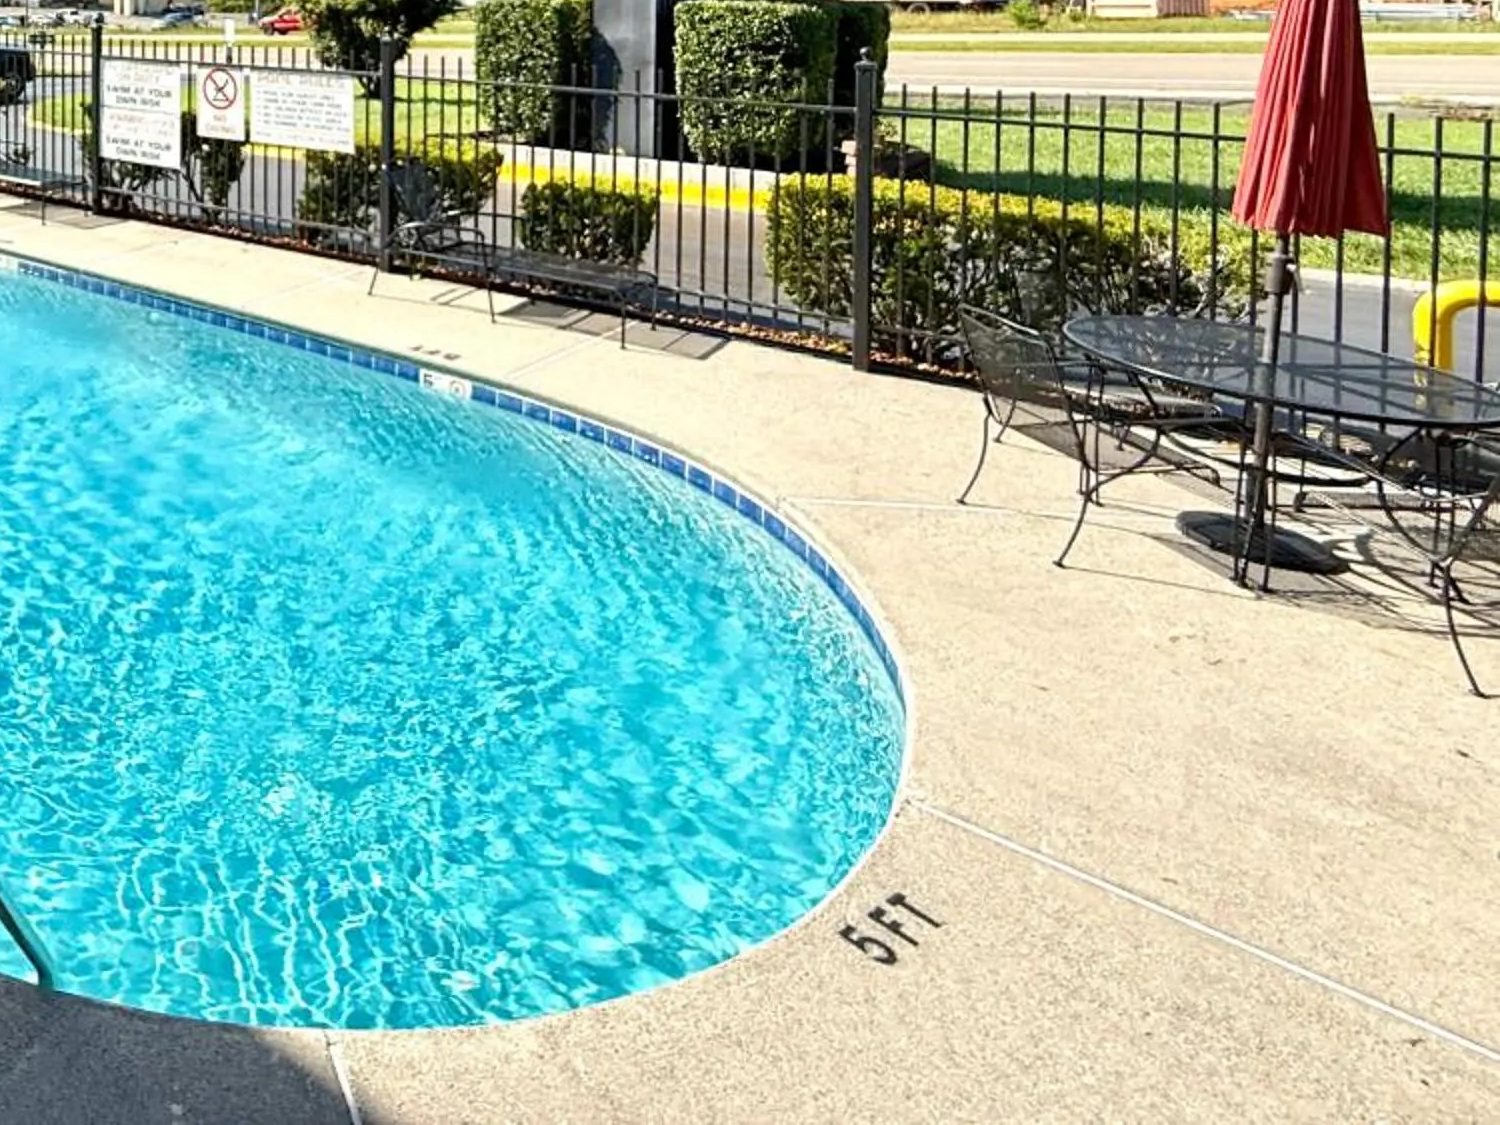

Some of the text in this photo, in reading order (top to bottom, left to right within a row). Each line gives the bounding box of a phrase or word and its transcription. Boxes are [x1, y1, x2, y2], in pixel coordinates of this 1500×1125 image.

[106, 84, 172, 98] SWIM AT YOUR
[106, 136, 172, 152] SWIM AT YOUR
